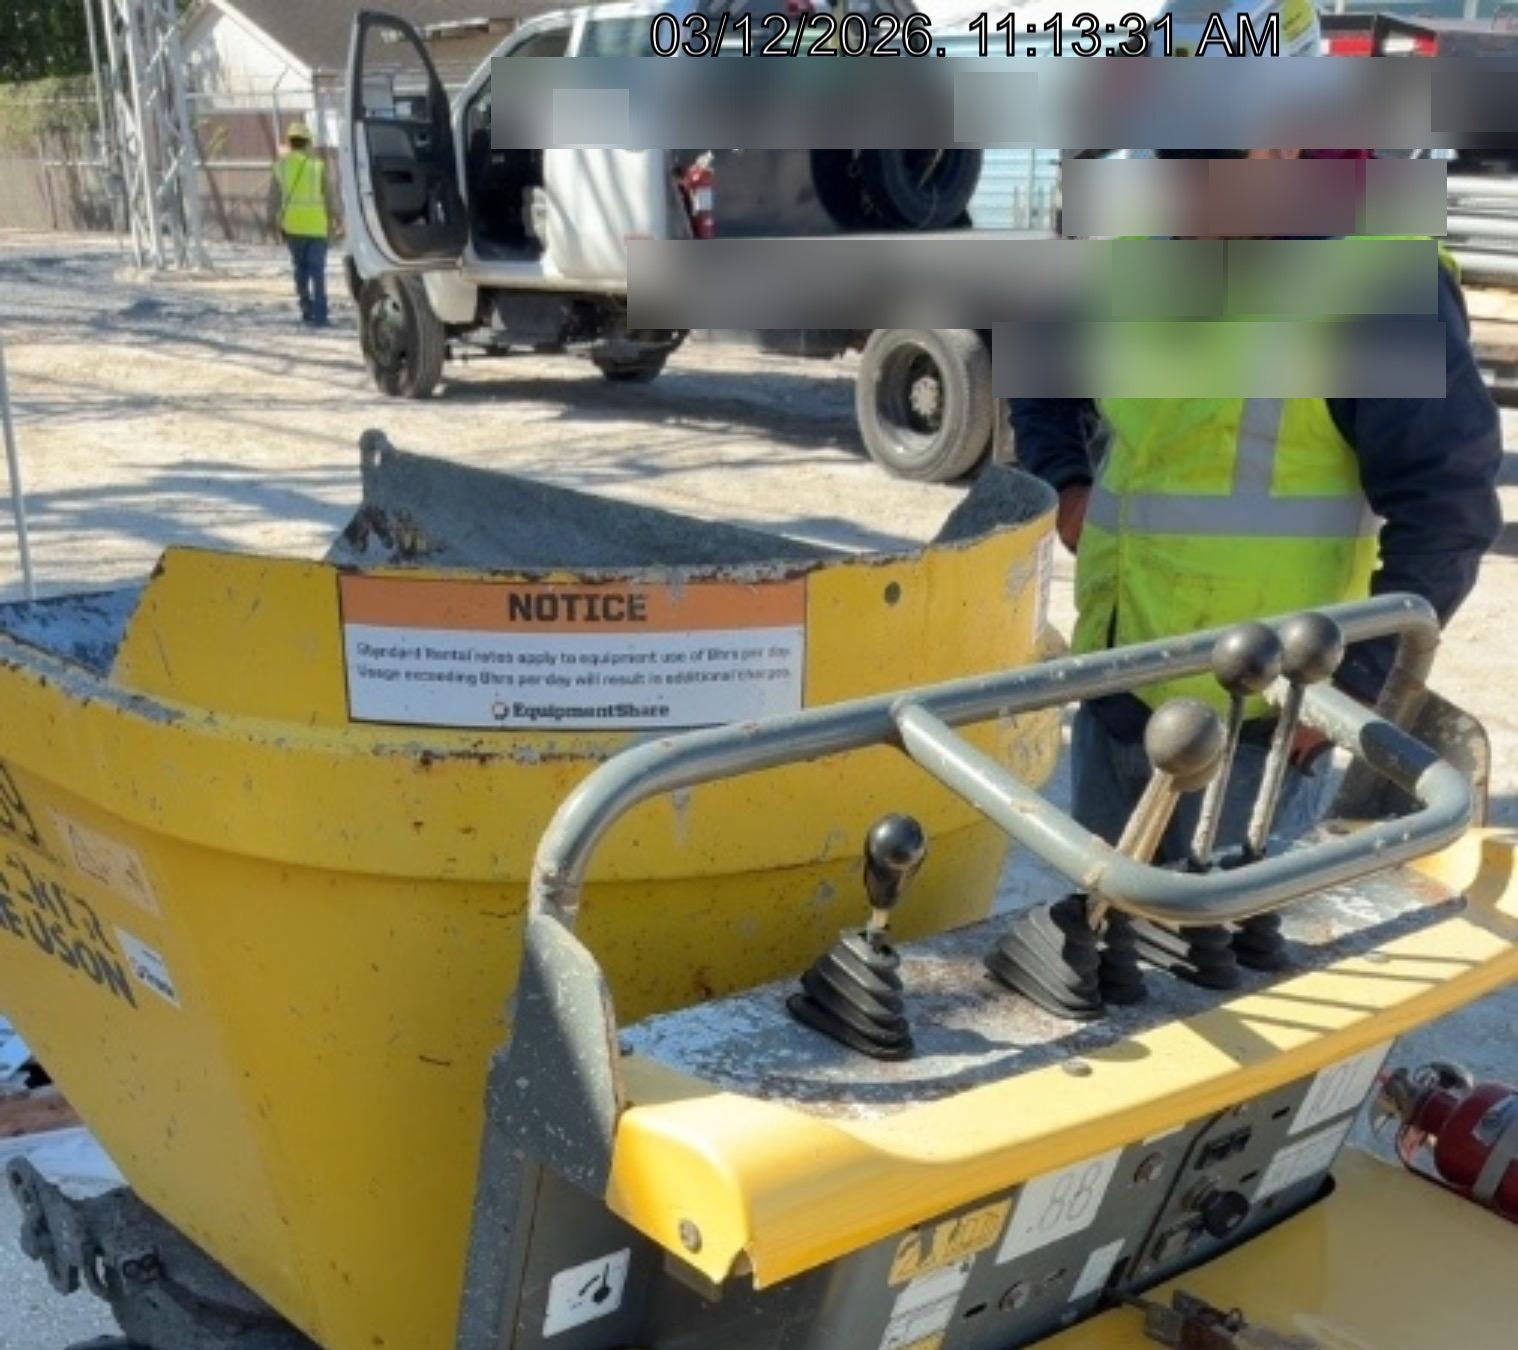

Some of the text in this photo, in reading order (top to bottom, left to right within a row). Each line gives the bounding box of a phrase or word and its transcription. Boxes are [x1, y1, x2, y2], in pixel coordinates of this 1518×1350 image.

[508, 593, 647, 622] NOTICE
[356, 641, 421, 661] Standard
[425, 645, 472, 662] Rental
[475, 648, 514, 664] rates
[518, 650, 556, 666] apply
[560, 650, 577, 664] to
[579, 649, 657, 667] equipment
[663, 652, 687, 664] use
[690, 649, 704, 662] of
[741, 648, 764, 662] per
[357, 664, 401, 682] Usage
[404, 666, 477, 687] exceeding
[518, 673, 542, 688] per
[545, 673, 571, 688] day
[575, 672, 600, 687] will
[603, 671, 645, 686] result
[650, 671, 664, 685] in
[666, 668, 735, 685] additional
[511, 703, 670, 720] EquipmentShare
